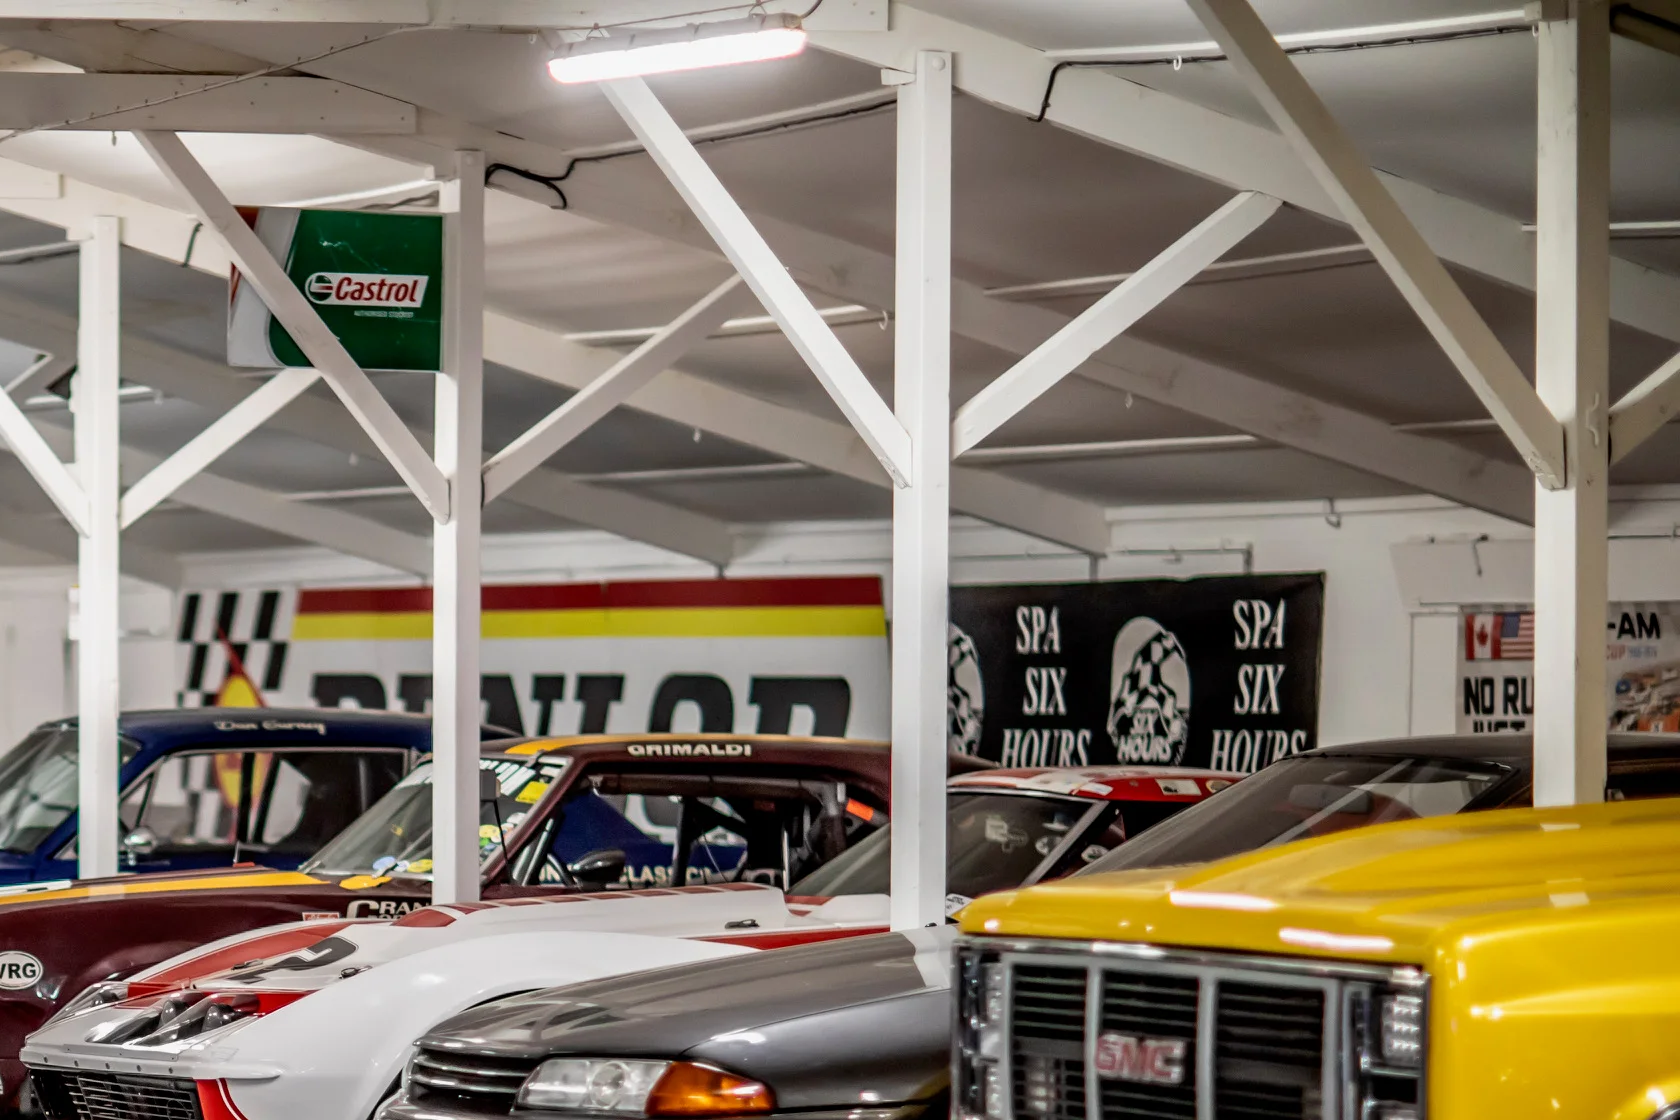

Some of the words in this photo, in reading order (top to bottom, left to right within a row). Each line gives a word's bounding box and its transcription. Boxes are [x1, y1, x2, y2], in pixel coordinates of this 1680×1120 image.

[335, 277, 418, 302] Castrol
[1016, 605, 1060, 654] SPA
[1233, 598, 1286, 649] SPA
[1023, 667, 1067, 715] SIX
[1234, 664, 1286, 714] SIX
[1464, 677, 1494, 715] NO
[627, 744, 751, 756] GRIMALDI
[1001, 728, 1092, 767] HOURS
[1096, 1034, 1184, 1083] GMC
